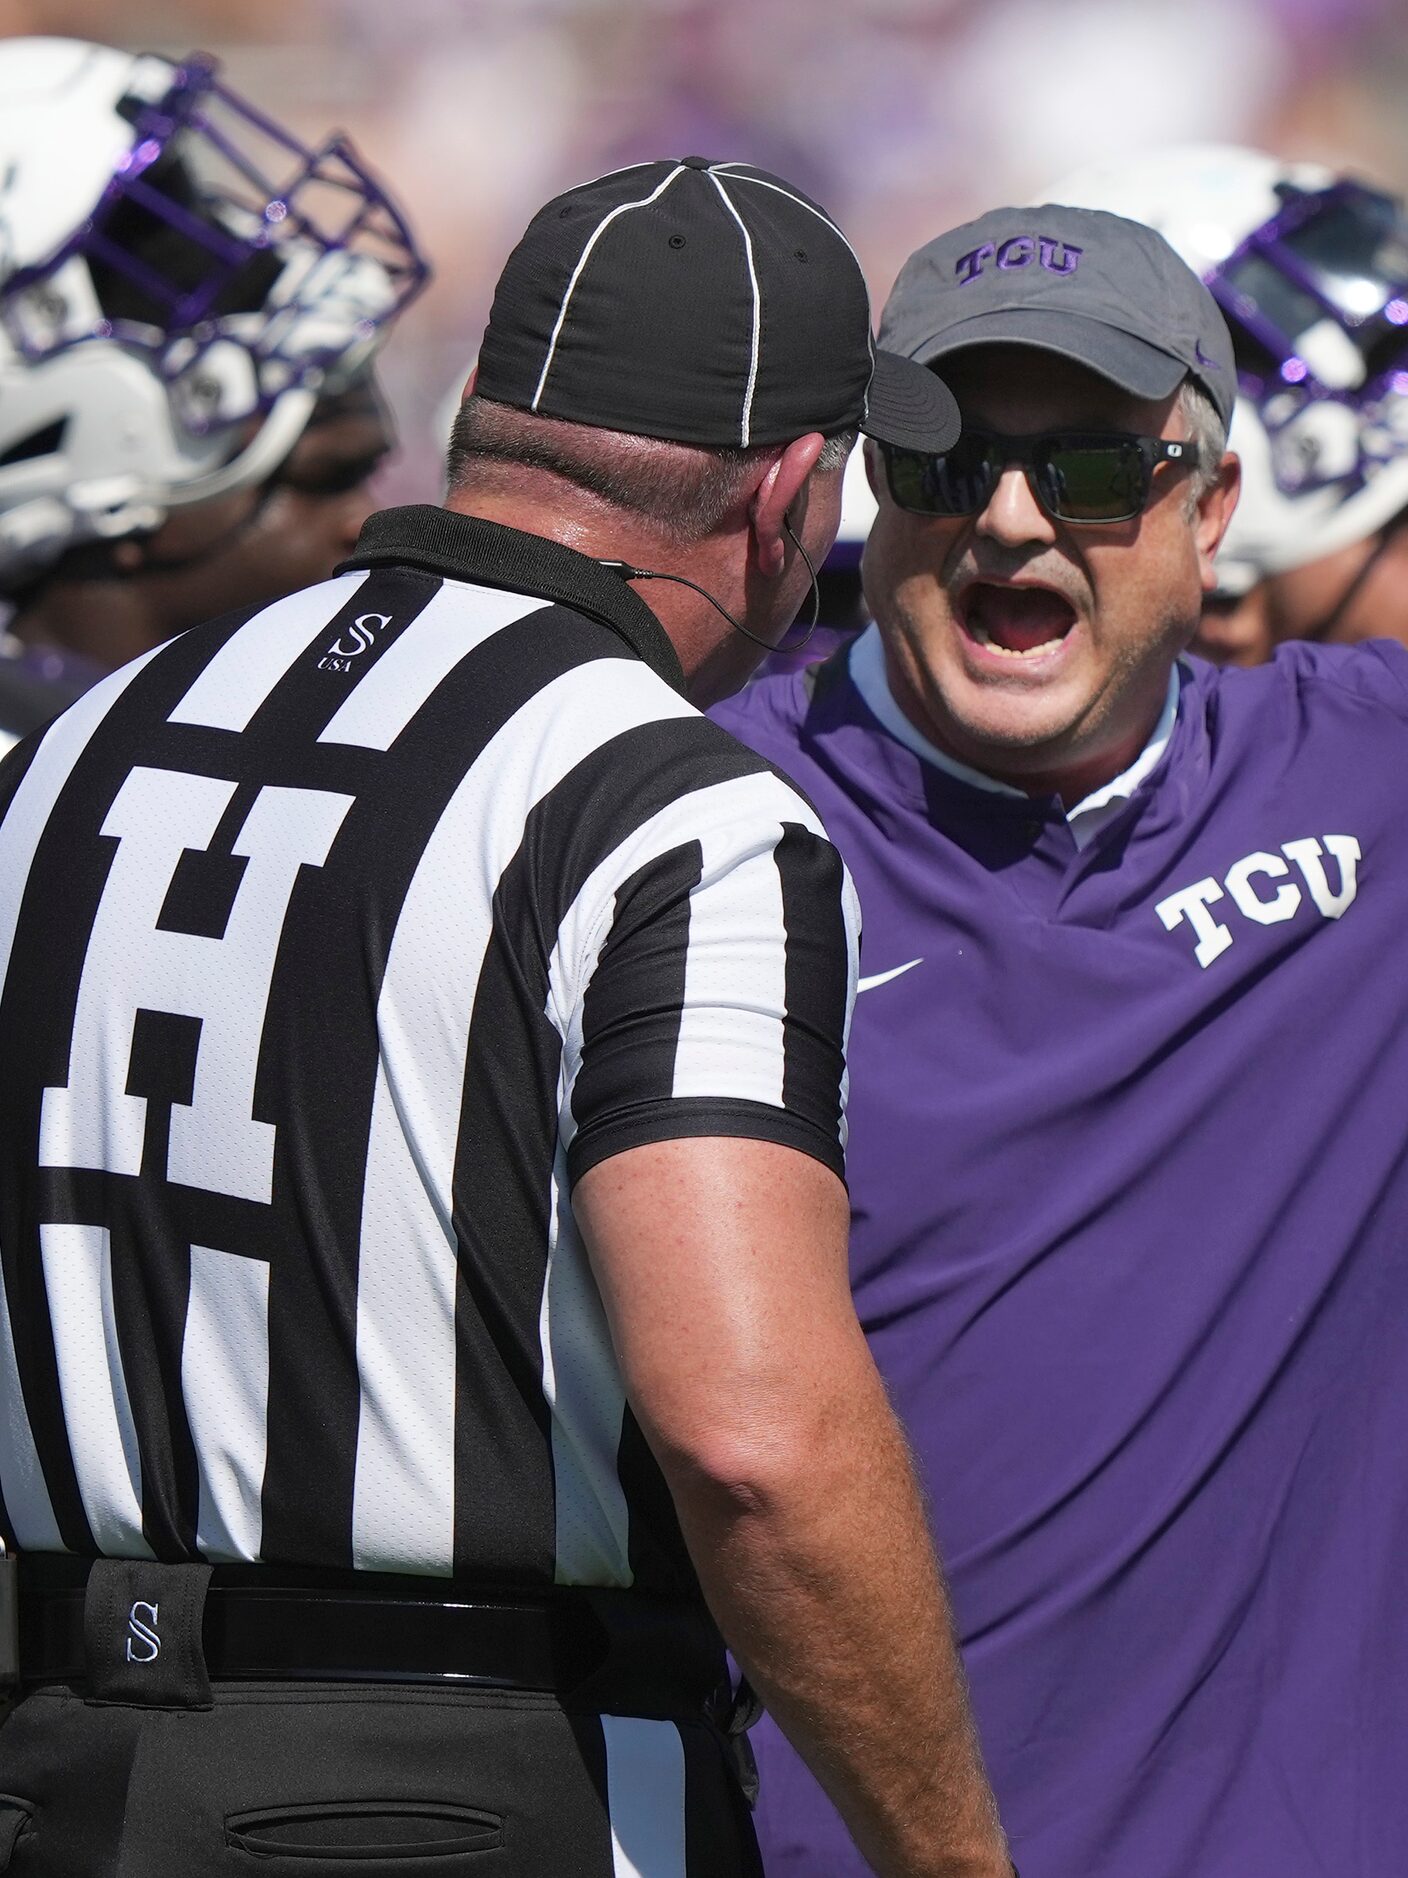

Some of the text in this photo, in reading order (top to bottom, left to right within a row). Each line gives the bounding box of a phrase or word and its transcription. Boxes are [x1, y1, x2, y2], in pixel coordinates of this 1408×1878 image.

[955, 235, 1084, 287] TCU
[317, 657, 352, 673] USA
[1154, 834, 1362, 969] TCU
[38, 765, 357, 1206] H
